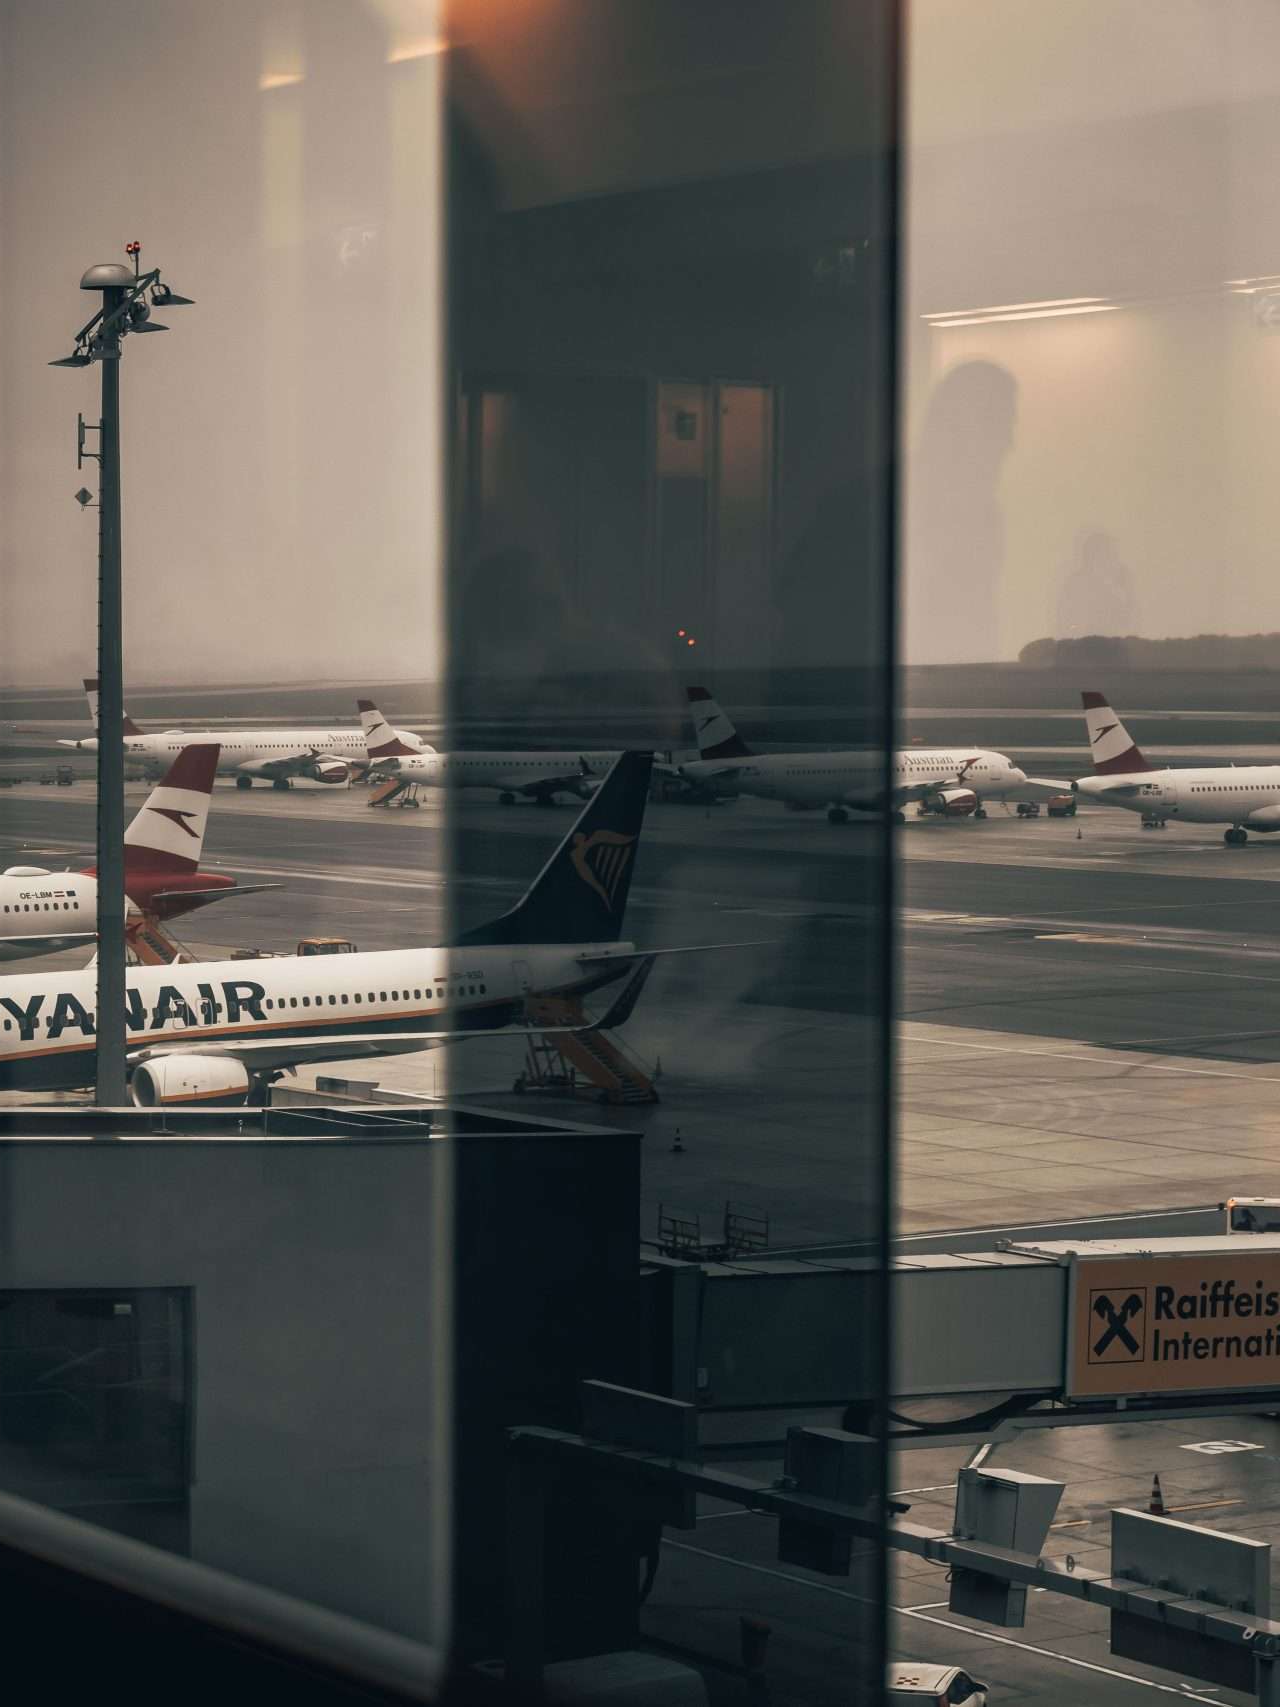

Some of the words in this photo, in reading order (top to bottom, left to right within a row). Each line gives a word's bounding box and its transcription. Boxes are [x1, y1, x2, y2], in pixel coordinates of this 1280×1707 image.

[904, 755, 954, 765] Austrian
[1155, 1280, 1280, 1320] Raiffeis
[1153, 1324, 1280, 1361] Internati
